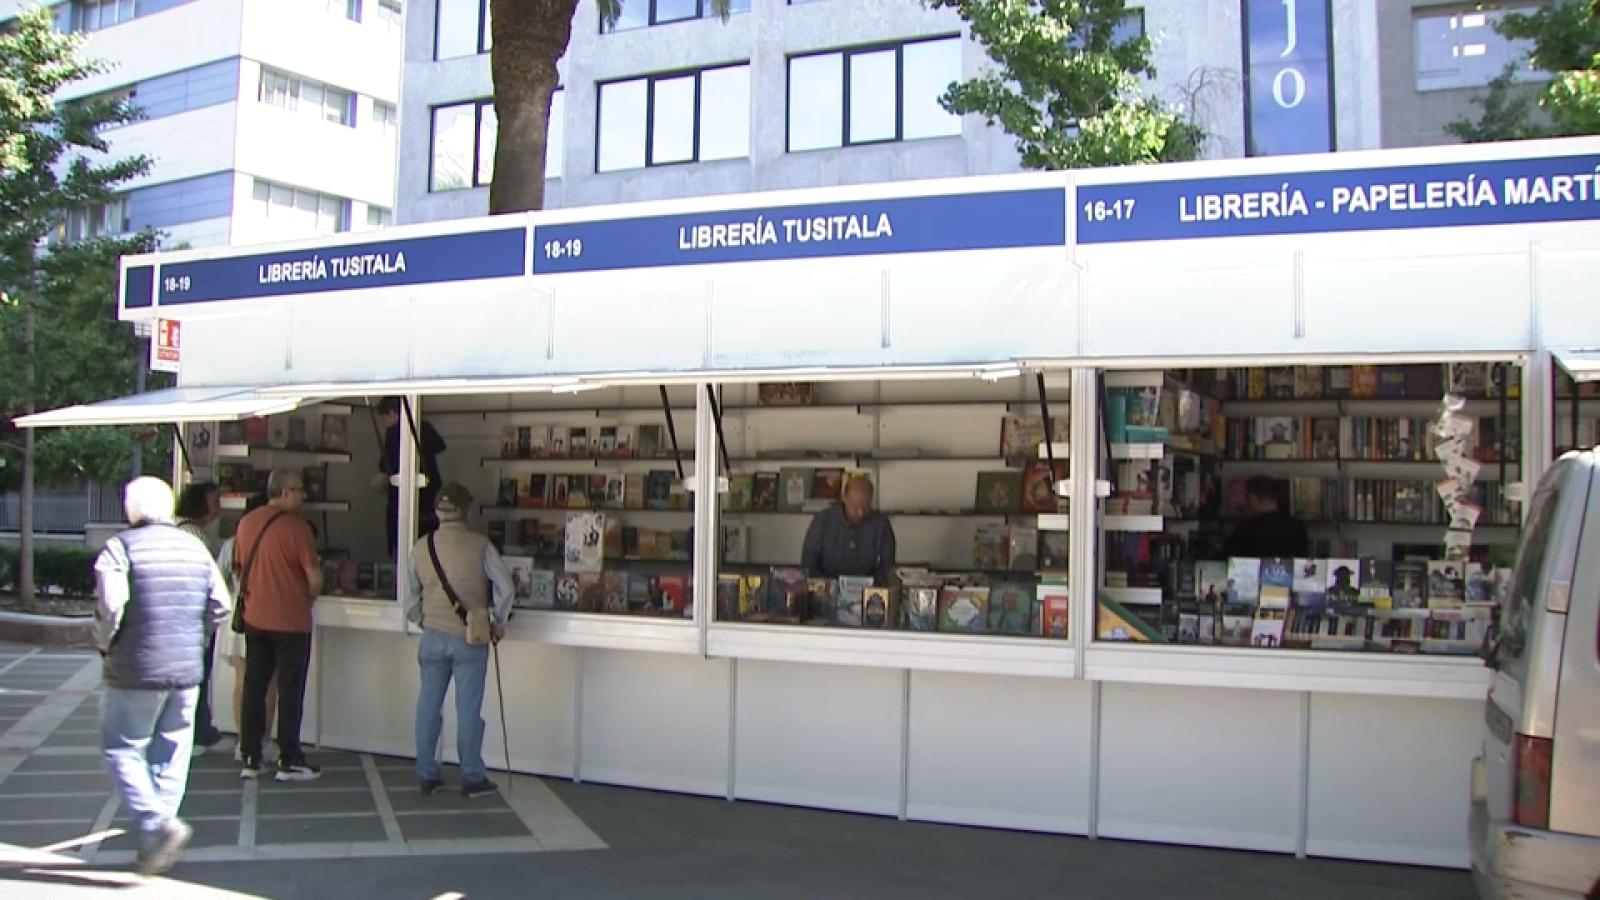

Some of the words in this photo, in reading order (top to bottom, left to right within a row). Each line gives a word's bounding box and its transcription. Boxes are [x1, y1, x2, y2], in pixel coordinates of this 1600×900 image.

[1084, 199, 1136, 222] 16-17
[1179, 183, 1309, 223] LIBRERÍA
[1315, 200, 1326, 209] -
[1332, 173, 1498, 214] PAPELERÍA
[679, 215, 778, 250] LIBRERÍA
[782, 212, 893, 243] TUSITALA
[544, 239, 582, 259] 18-19
[258, 256, 327, 284] LIBRERÍA
[331, 251, 406, 277] TUSITALA
[164, 275, 191, 292] 18-19
